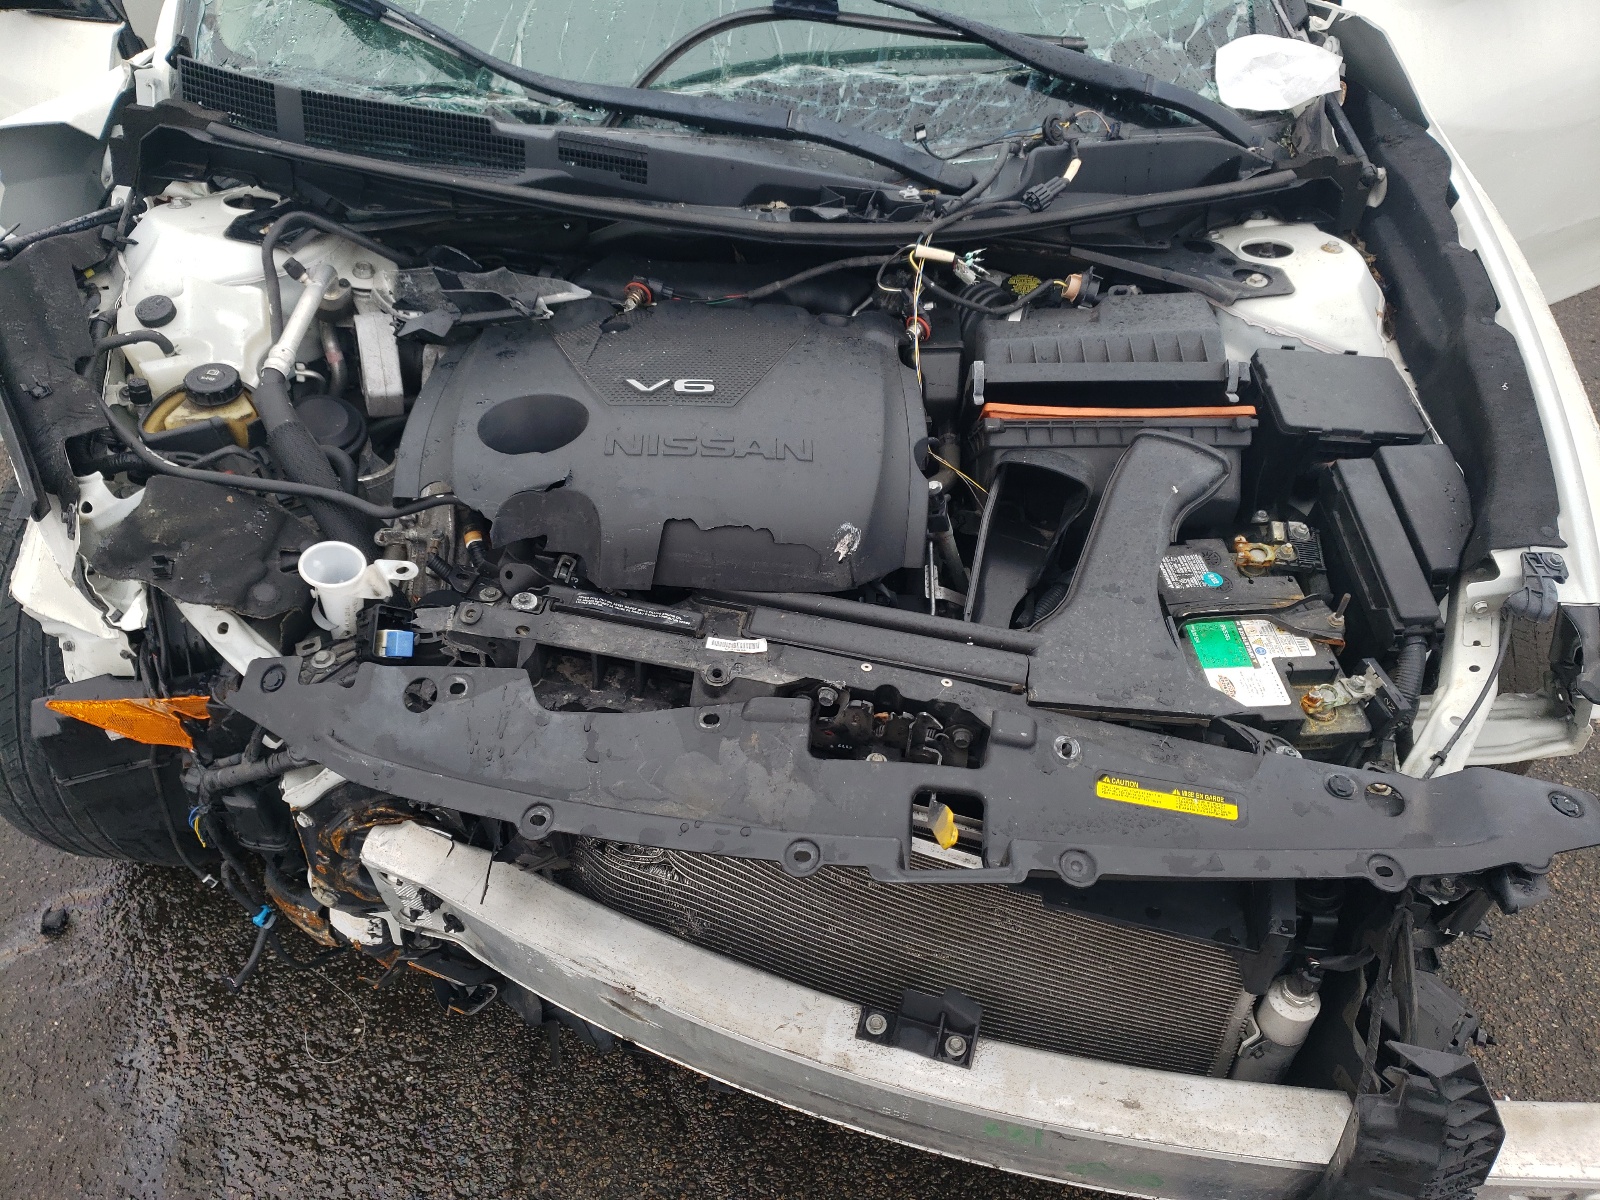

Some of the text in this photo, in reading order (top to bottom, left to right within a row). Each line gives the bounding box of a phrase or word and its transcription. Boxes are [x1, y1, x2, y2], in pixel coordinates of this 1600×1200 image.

[625, 378, 716, 396] V6
[604, 434, 814, 462] NISSAN
[1111, 777, 1139, 789] CAUTION
[1181, 789, 1226, 804] MISE EN GARDE
